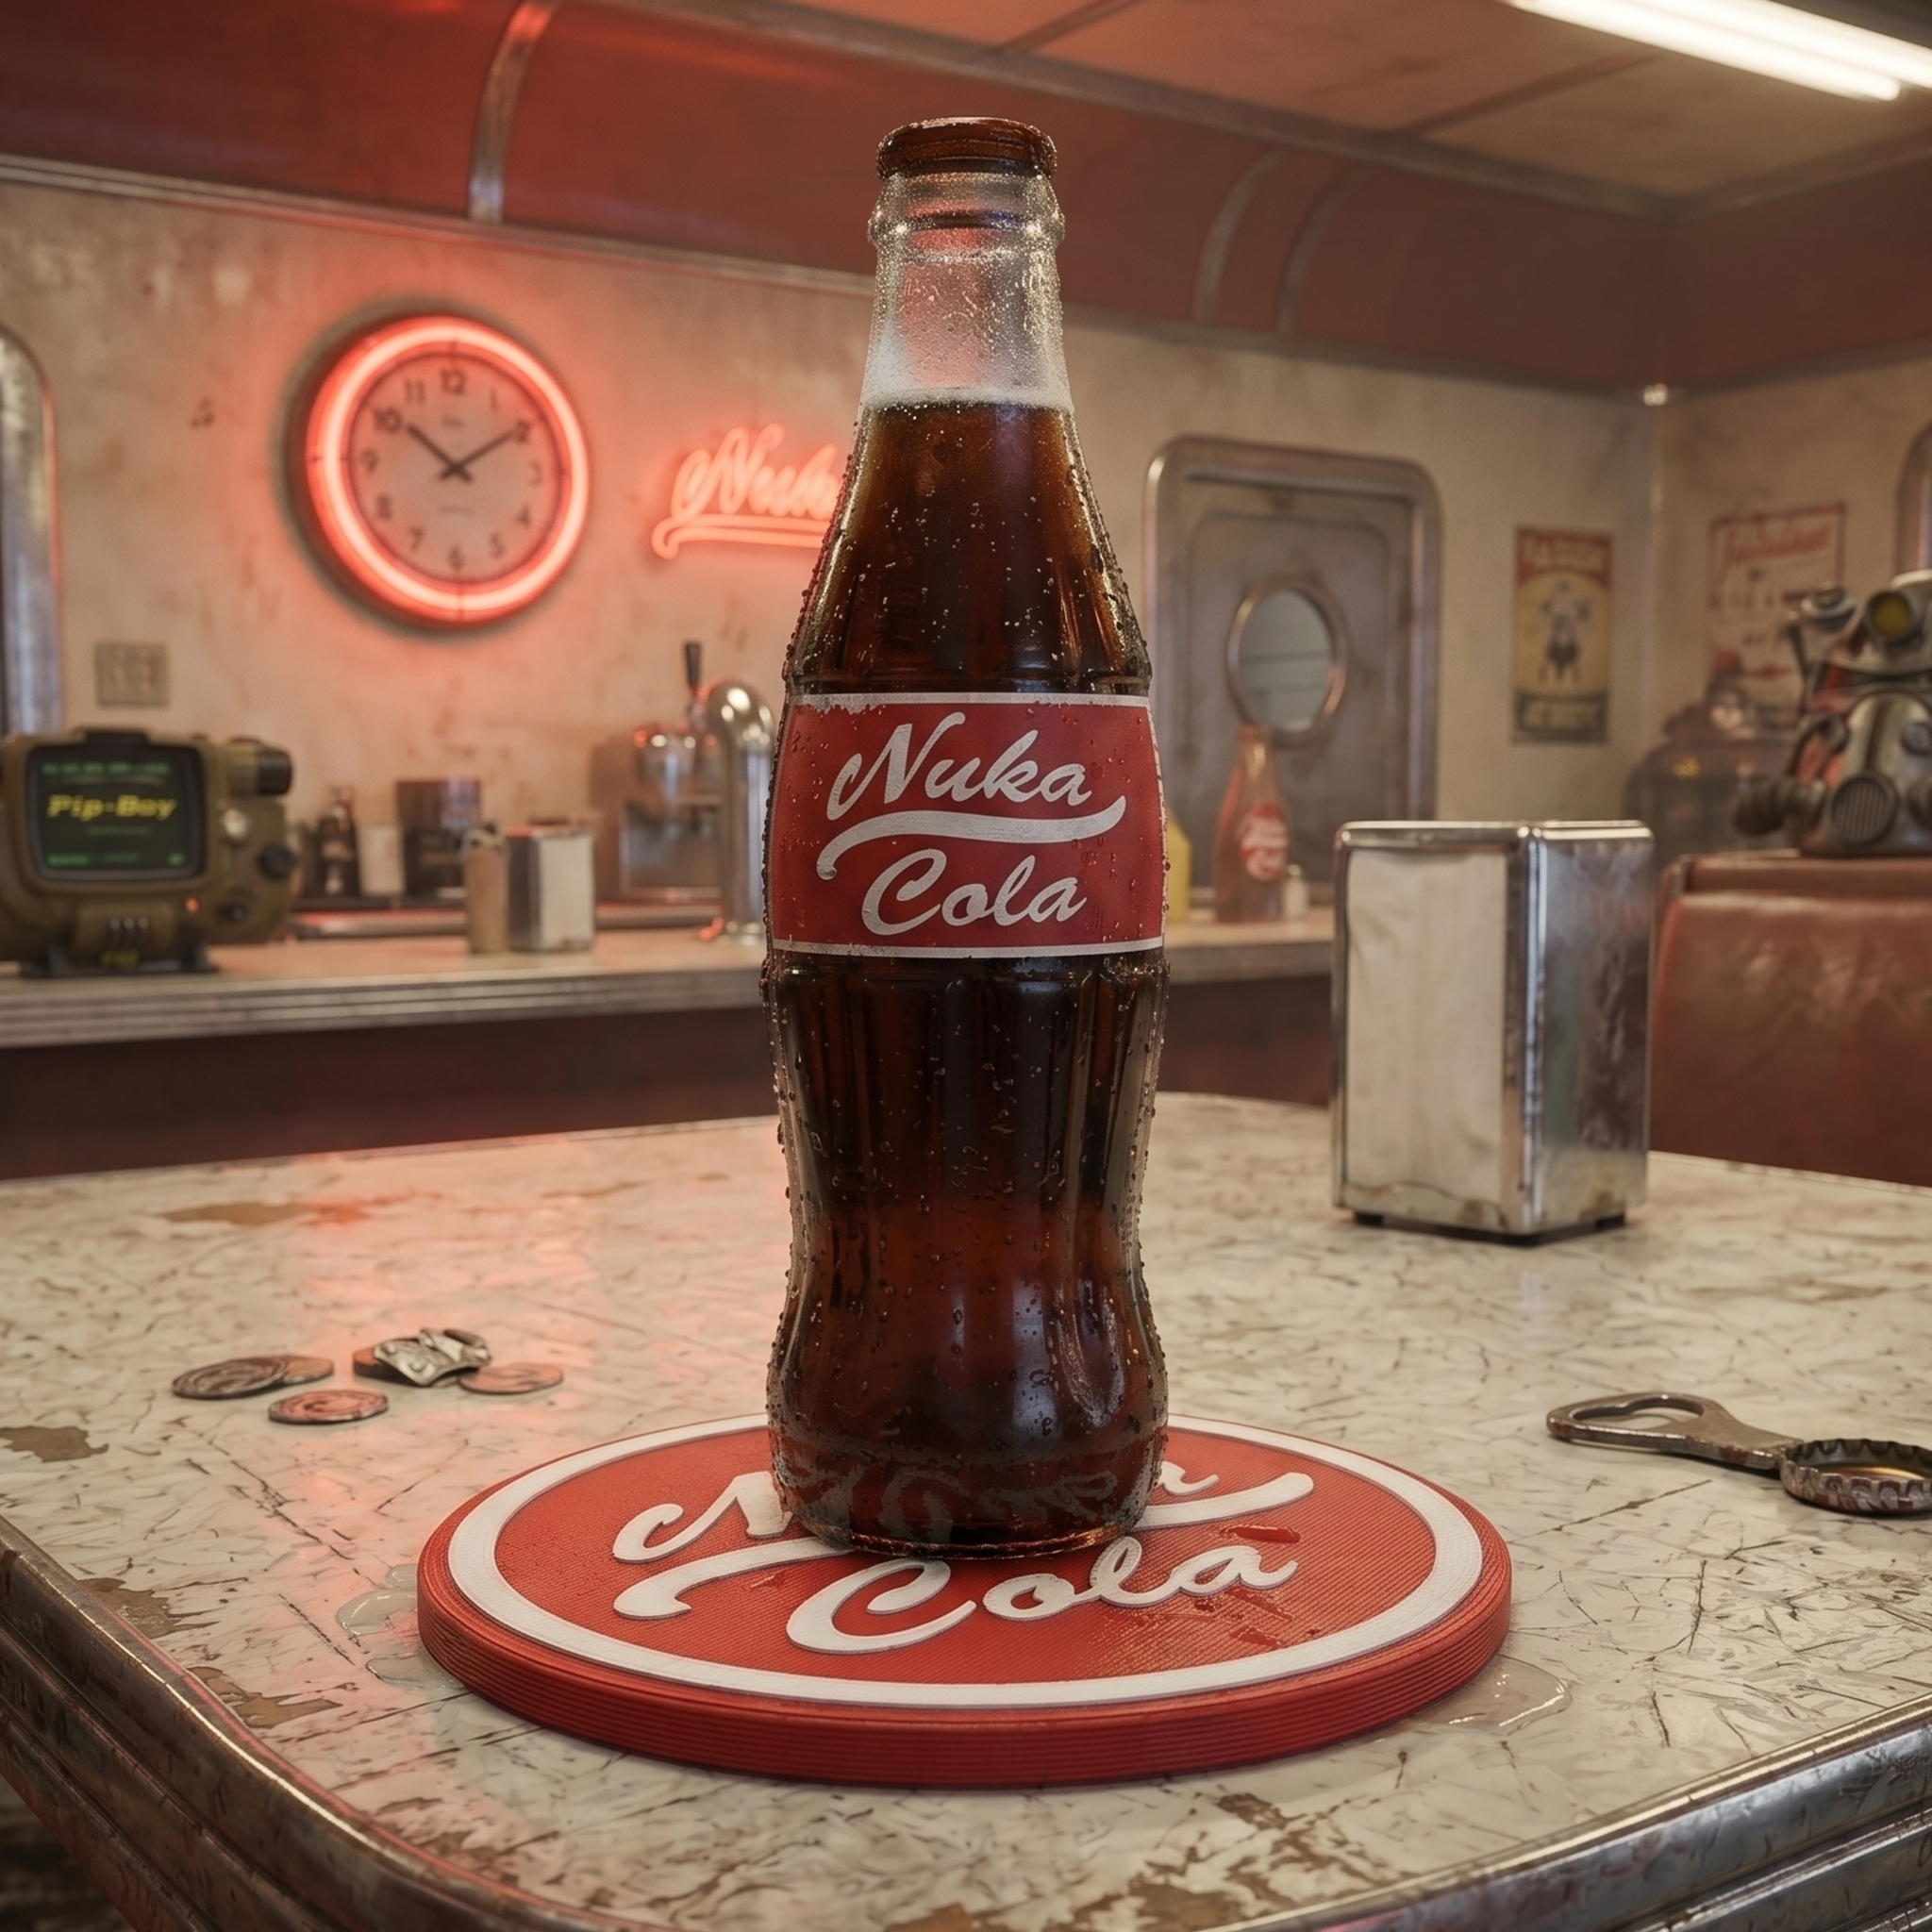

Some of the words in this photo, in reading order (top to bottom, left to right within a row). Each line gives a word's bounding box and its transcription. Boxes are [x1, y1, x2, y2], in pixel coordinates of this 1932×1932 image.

[405, 379, 425, 406] 11
[489, 387, 499, 413] 1
[359, 447, 379, 475] 9
[529, 459, 543, 487] 3
[407, 525, 425, 553] 7
[826, 711, 1092, 821] Nuka
[47, 794, 176, 822] Pip-Boy
[861, 848, 1088, 936] Cola
[786, 1536, 1299, 1655] Cola
